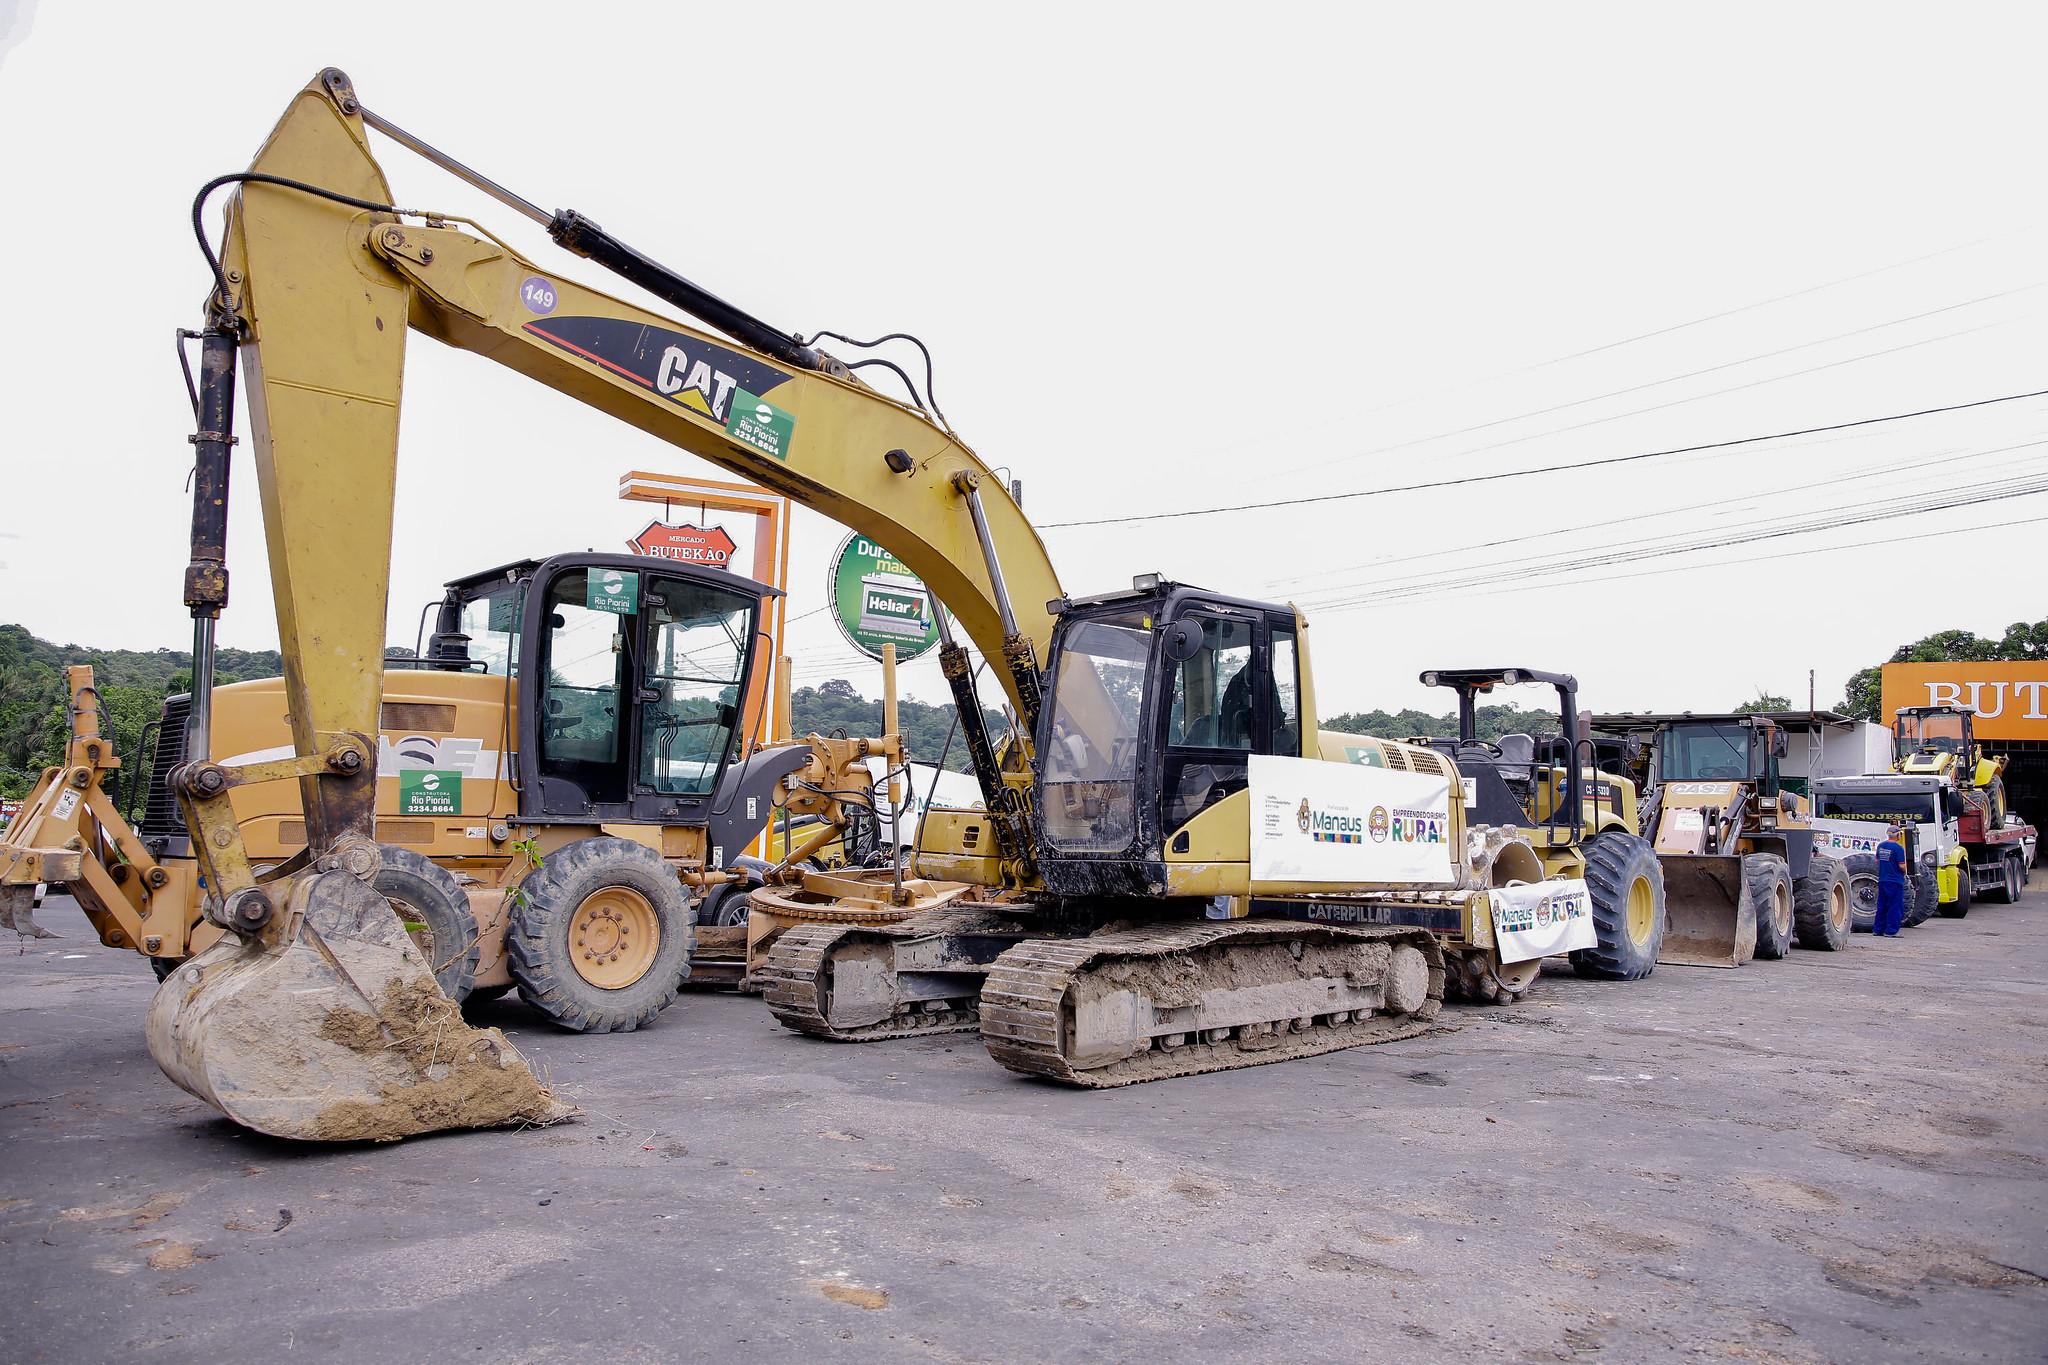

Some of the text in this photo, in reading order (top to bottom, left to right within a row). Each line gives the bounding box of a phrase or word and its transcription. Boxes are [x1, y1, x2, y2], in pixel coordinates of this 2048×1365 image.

[525, 284, 553, 307] 149
[656, 346, 737, 421] CAT
[740, 419, 779, 446] Rio Piorini
[742, 415, 779, 436] CONSTRUTORA
[734, 428, 779, 455] 3234.8664
[669, 535, 706, 544] MERCADO
[648, 545, 726, 562] BUTEKÃO
[876, 558, 911, 575] mais
[594, 596, 630, 608] Rio Piorini
[869, 596, 911, 614] Heliar
[1671, 783, 1731, 794] CASE
[408, 805, 454, 813] 3234.8664
[411, 796, 451, 805] Rio Piorini
[1313, 811, 1362, 832] Manaus
[1393, 809, 1447, 820] EMPREENDEDORISMO
[1392, 818, 1447, 843] RURAL
[1832, 838, 1878, 852] RURAL
[1307, 903, 1392, 924] CATERPILLAR
[1502, 908, 1532, 924] Manaus
[1552, 899, 1586, 923] RURAL
